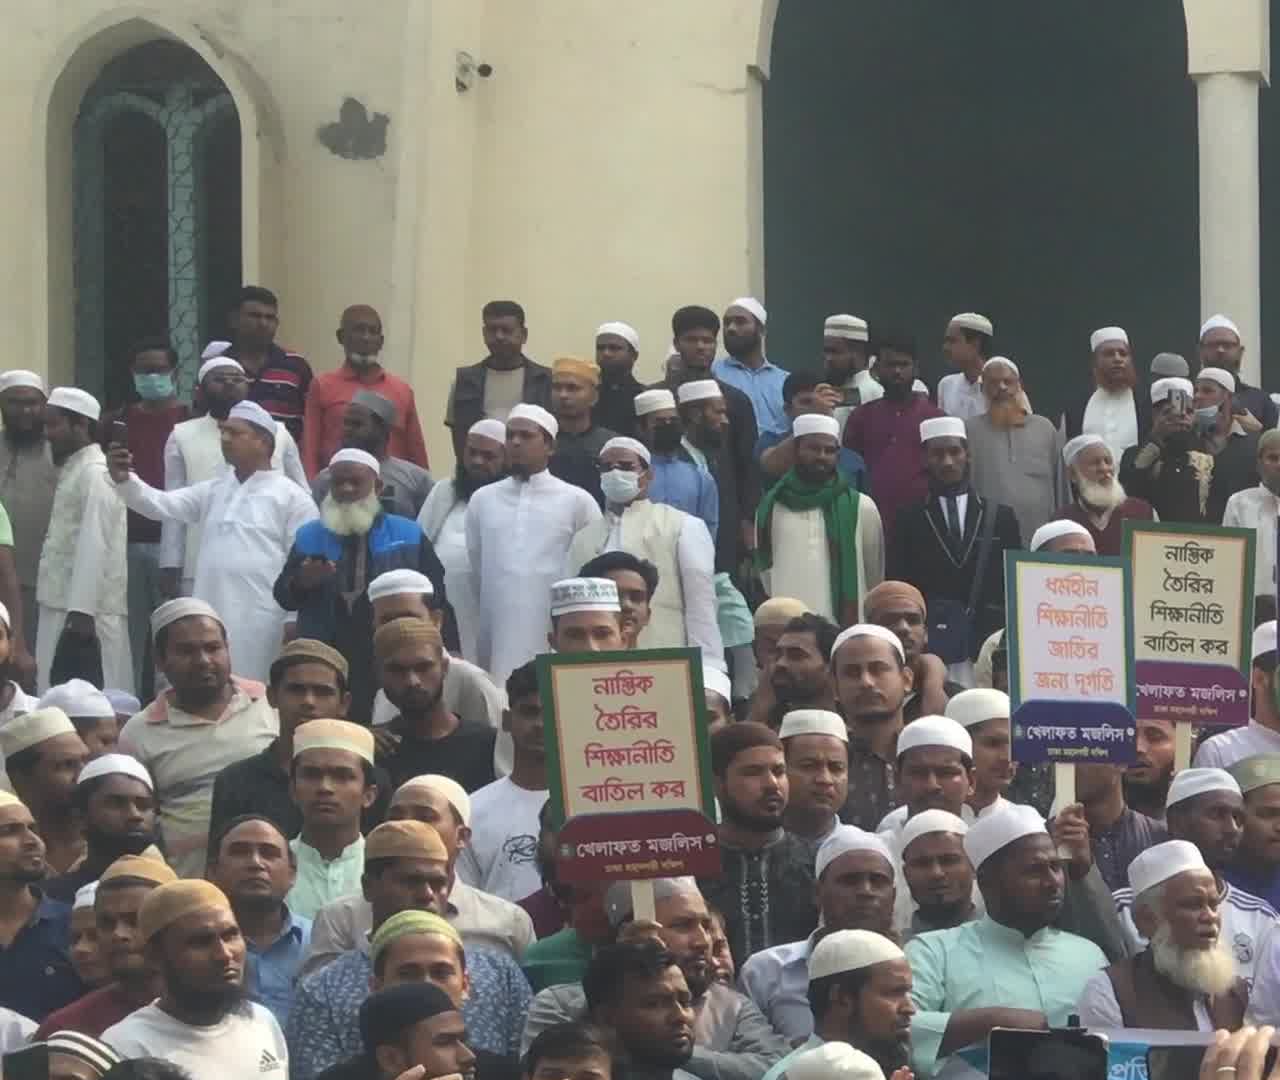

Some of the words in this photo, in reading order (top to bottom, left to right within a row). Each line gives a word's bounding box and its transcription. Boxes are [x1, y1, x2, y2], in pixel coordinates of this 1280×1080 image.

[1165, 541, 1215, 564] নাস্তিক
[1163, 569, 1214, 594] তৈরির
[1150, 600, 1224, 625] শিক্ষানীতি
[1144, 631, 1194, 653] বাতিল
[1200, 637, 1229, 655] কর
[592, 669, 654, 697] নাস্তিক
[595, 703, 658, 731] তৈরির
[584, 739, 675, 769] শিক্ষানীতি
[580, 777, 645, 803] বাতিল
[651, 779, 686, 800] কর
